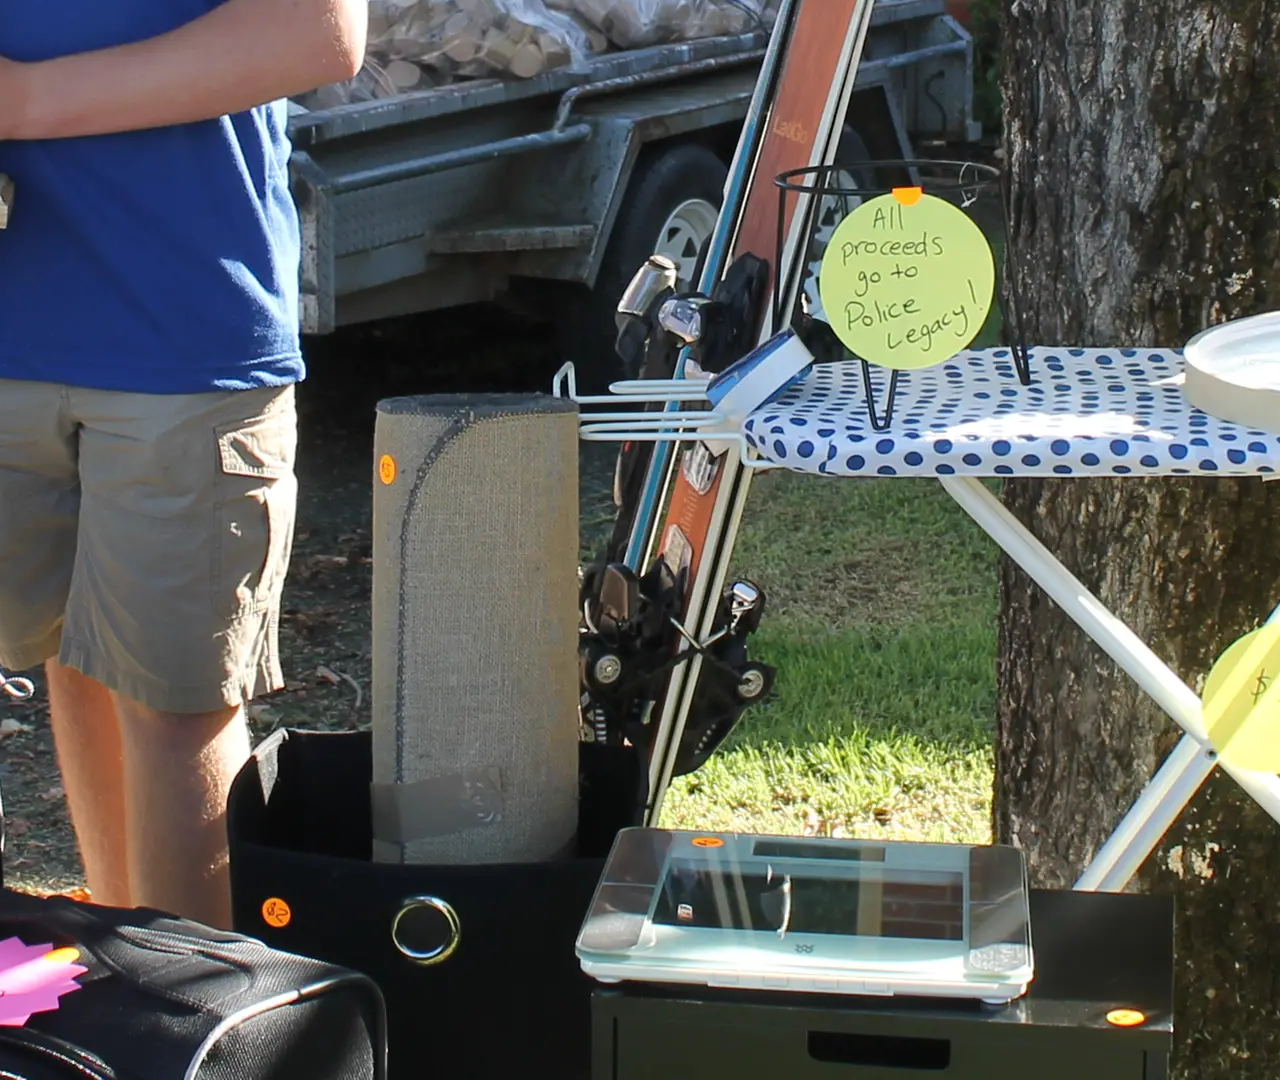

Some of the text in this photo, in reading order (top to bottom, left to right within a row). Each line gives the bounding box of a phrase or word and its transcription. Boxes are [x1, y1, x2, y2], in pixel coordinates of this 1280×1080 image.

[872, 204, 904, 230] All
[841, 232, 944, 266] proceeds
[854, 263, 918, 297] go to
[844, 296, 922, 331] Police
[266, 901, 289, 924] $2
